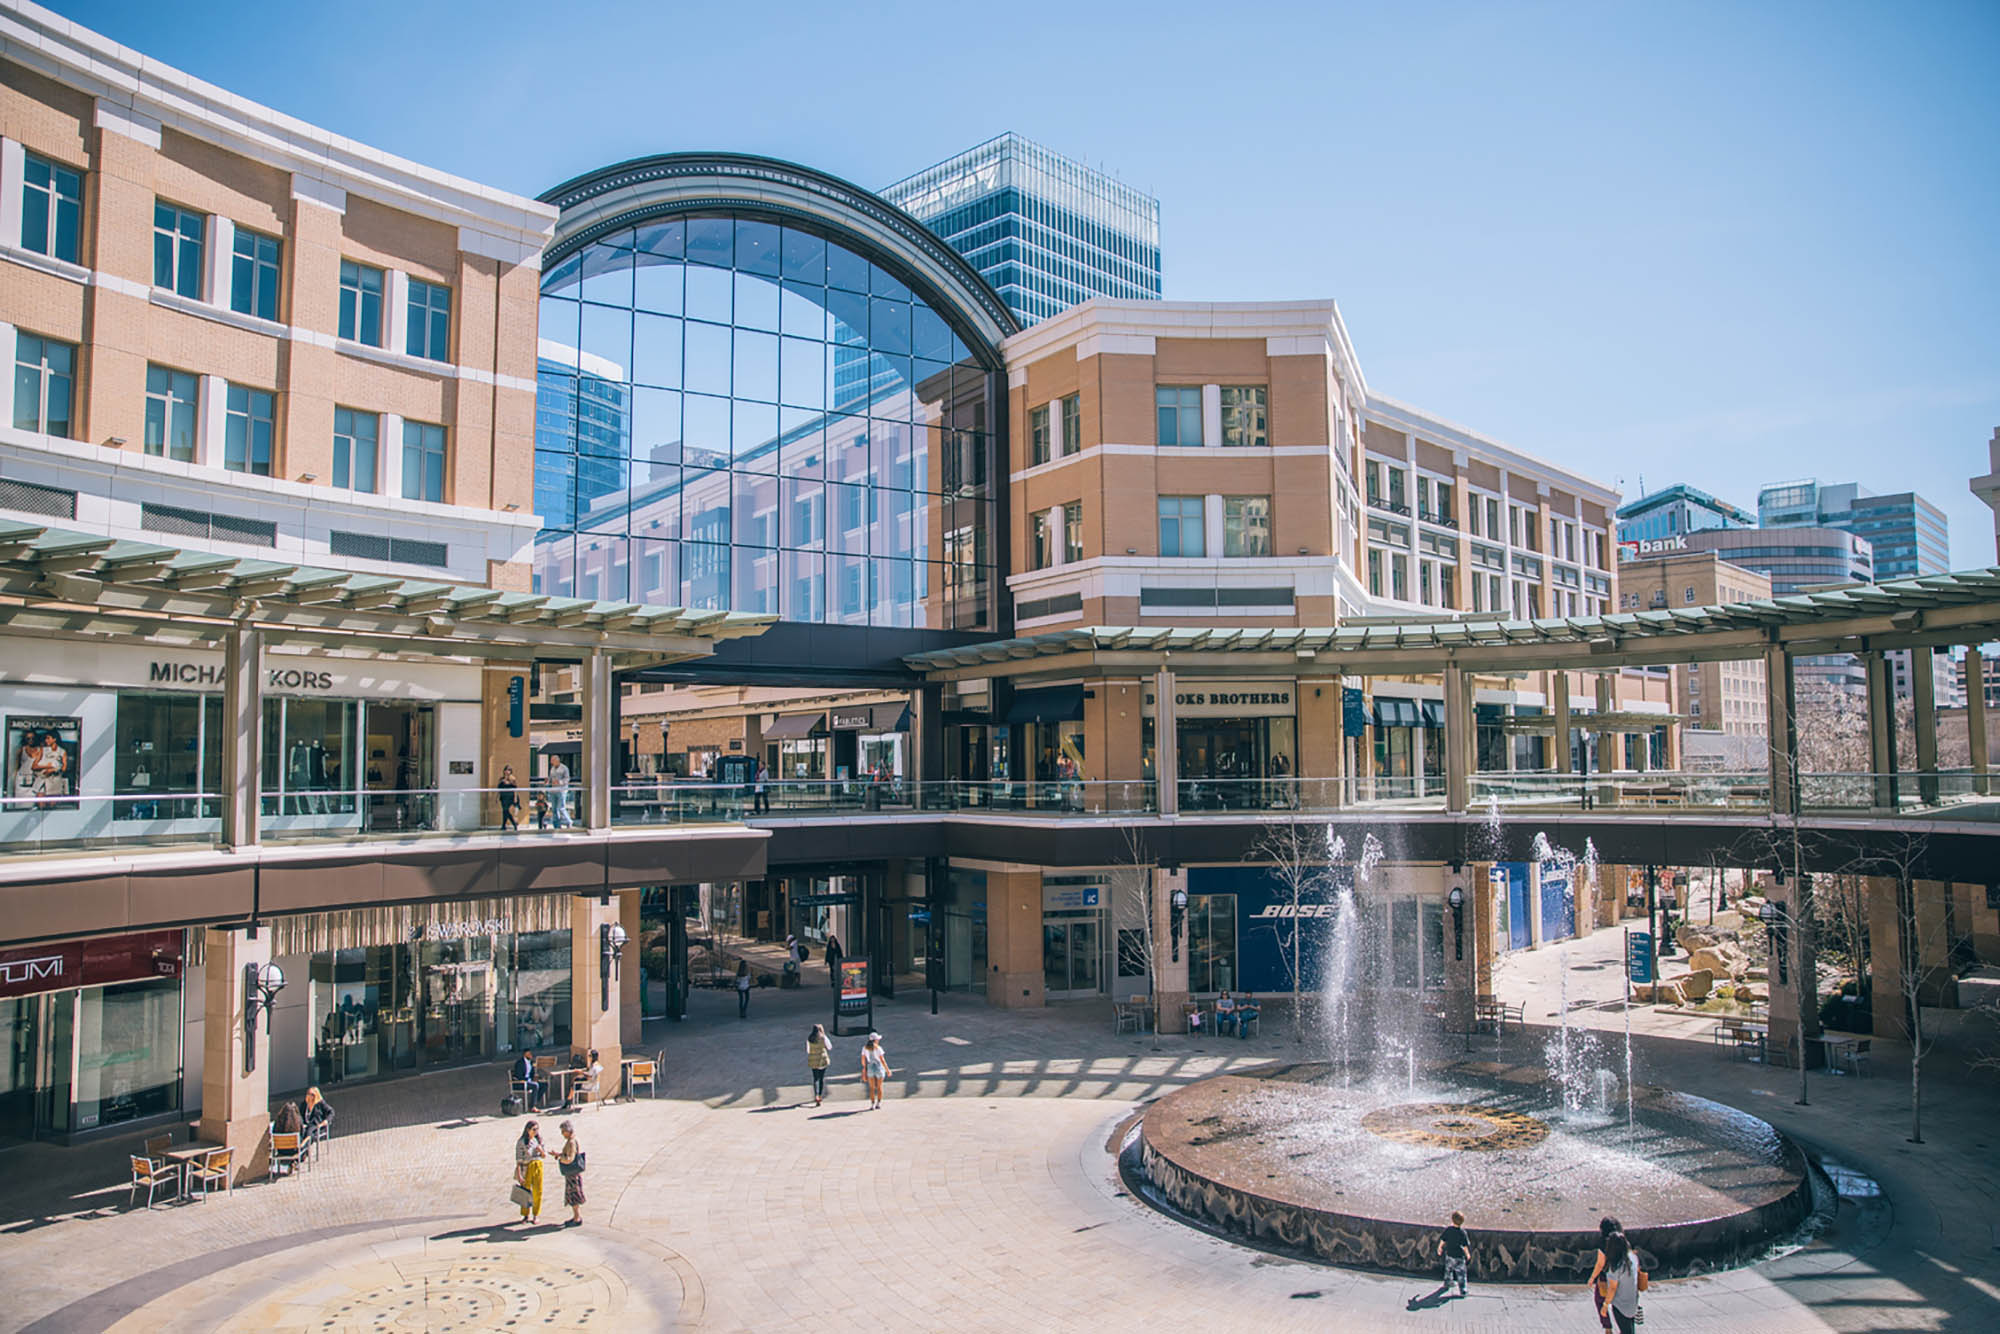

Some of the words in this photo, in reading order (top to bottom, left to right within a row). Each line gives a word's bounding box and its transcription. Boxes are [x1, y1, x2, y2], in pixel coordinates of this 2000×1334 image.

[1640, 536, 1687, 552] bank
[151, 662, 226, 684] MICHA
[270, 669, 332, 689] KORS
[1146, 693, 1205, 705] BOKS
[1210, 693, 1289, 704] BROTHERS
[1249, 904, 1335, 918] BOSE
[427, 918, 510, 939] SWAROVSKI
